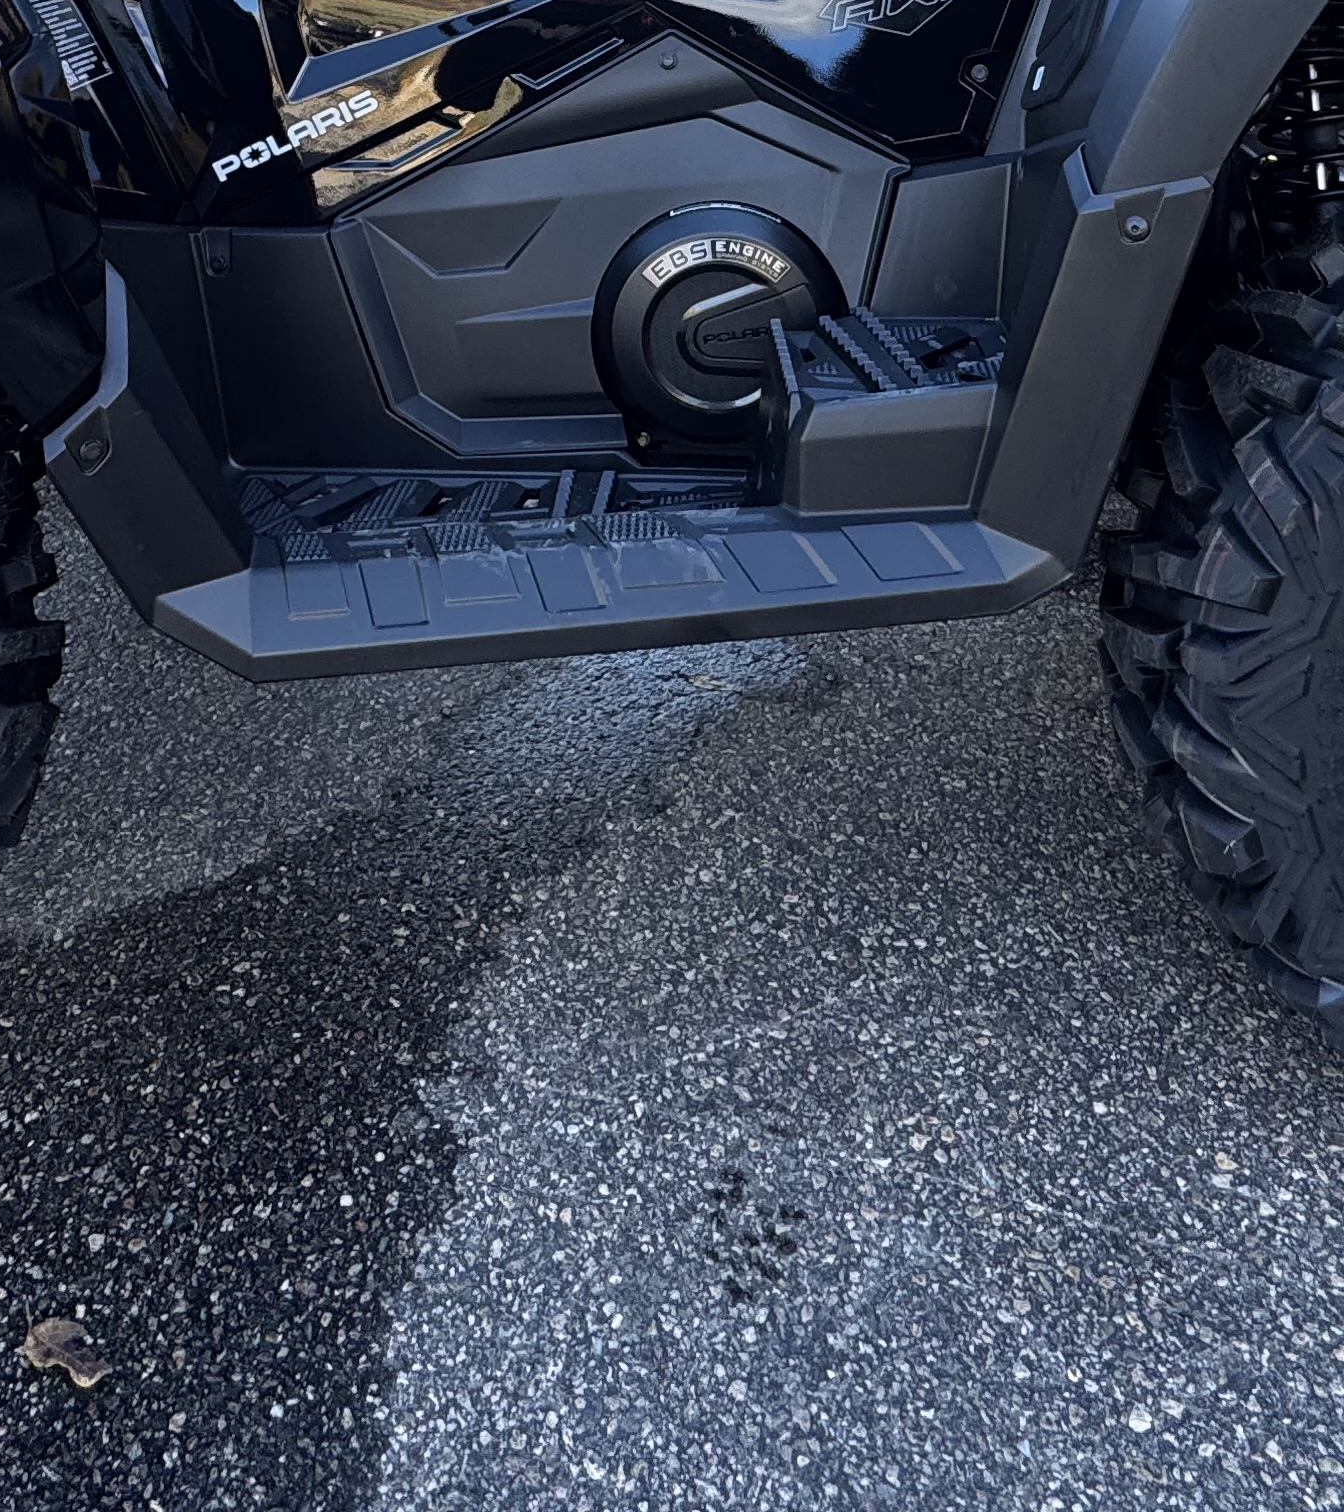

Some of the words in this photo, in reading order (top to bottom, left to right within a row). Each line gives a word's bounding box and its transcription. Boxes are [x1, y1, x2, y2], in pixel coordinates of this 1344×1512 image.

[211, 89, 379, 183] POLARIS
[650, 241, 708, 281] EBS
[715, 240, 786, 273] ENGINE
[702, 326, 771, 346] POLAR
